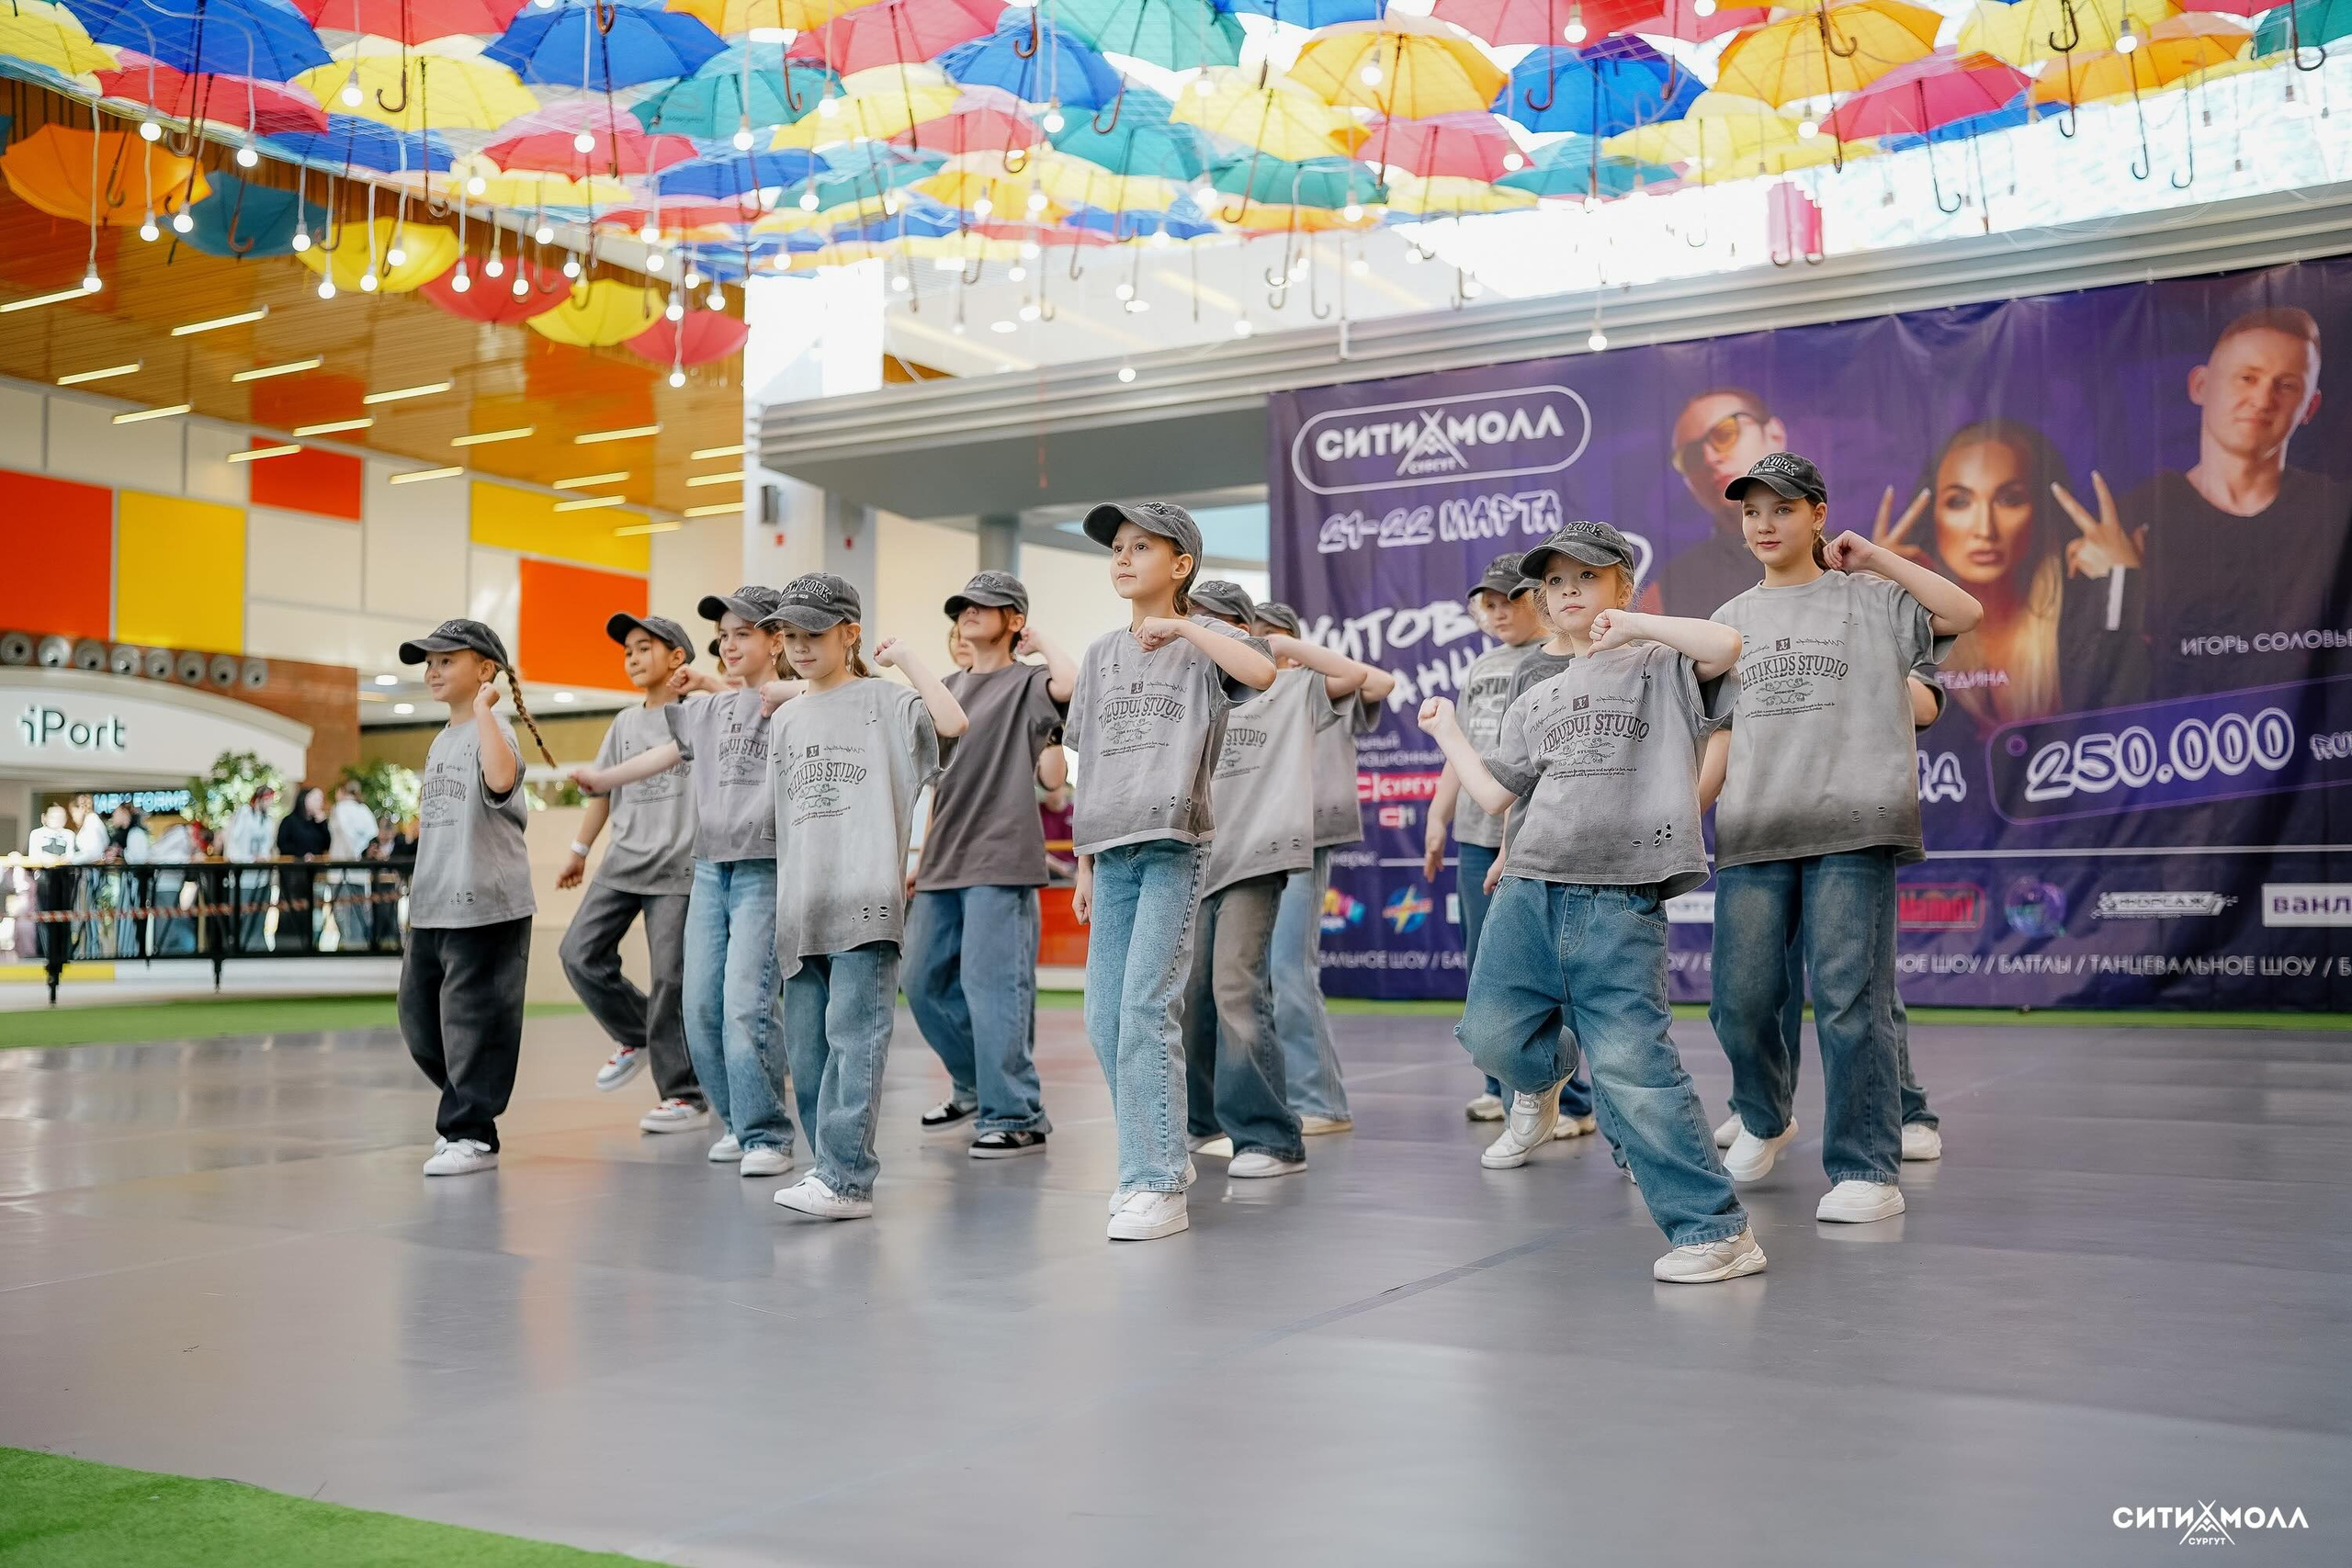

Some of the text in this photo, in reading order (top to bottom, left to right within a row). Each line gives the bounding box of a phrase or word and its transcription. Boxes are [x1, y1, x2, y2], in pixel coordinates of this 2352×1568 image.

[1317, 489, 1563, 554] 21-22 МАРТА
[801, 580, 832, 603] YORK
[2180, 635, 2249, 656] ИГОРЬ
[1798, 655, 1849, 680] STUDIO
[21, 705, 125, 749] iPort
[1226, 728, 1267, 747] STUDIO
[2025, 708, 2295, 802] 250.000
[825, 761, 867, 784] STUDIO
[1931, 953, 1981, 974] ШОУ
[2089, 954, 2256, 976] ТАНЦЕВАЛЬНОЕ
[2259, 955, 2316, 976] ШОУ
